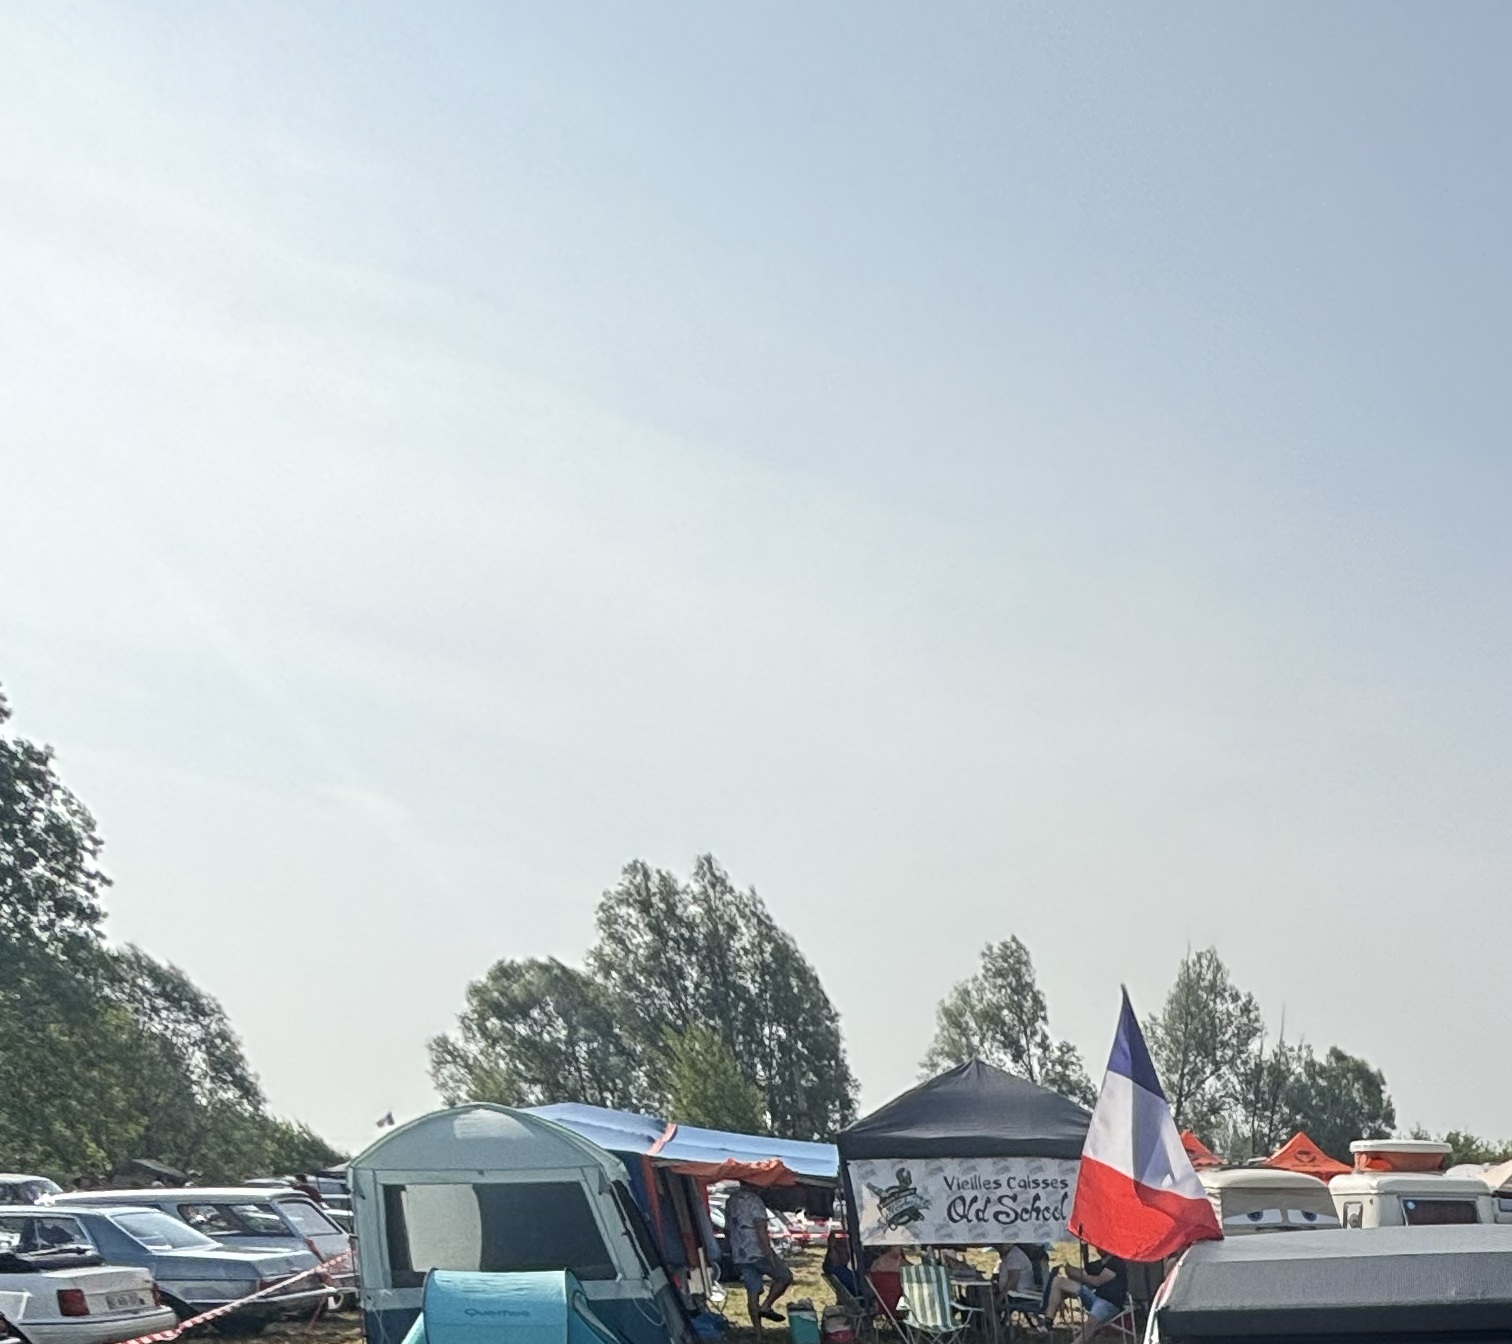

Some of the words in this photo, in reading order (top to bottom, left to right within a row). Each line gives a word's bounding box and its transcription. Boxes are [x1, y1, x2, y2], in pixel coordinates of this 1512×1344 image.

[943, 1175, 1002, 1191] Vieilles
[1006, 1174, 1069, 1190] Caisses
[946, 1195, 989, 1224] Old
[992, 1191, 1068, 1225] School
